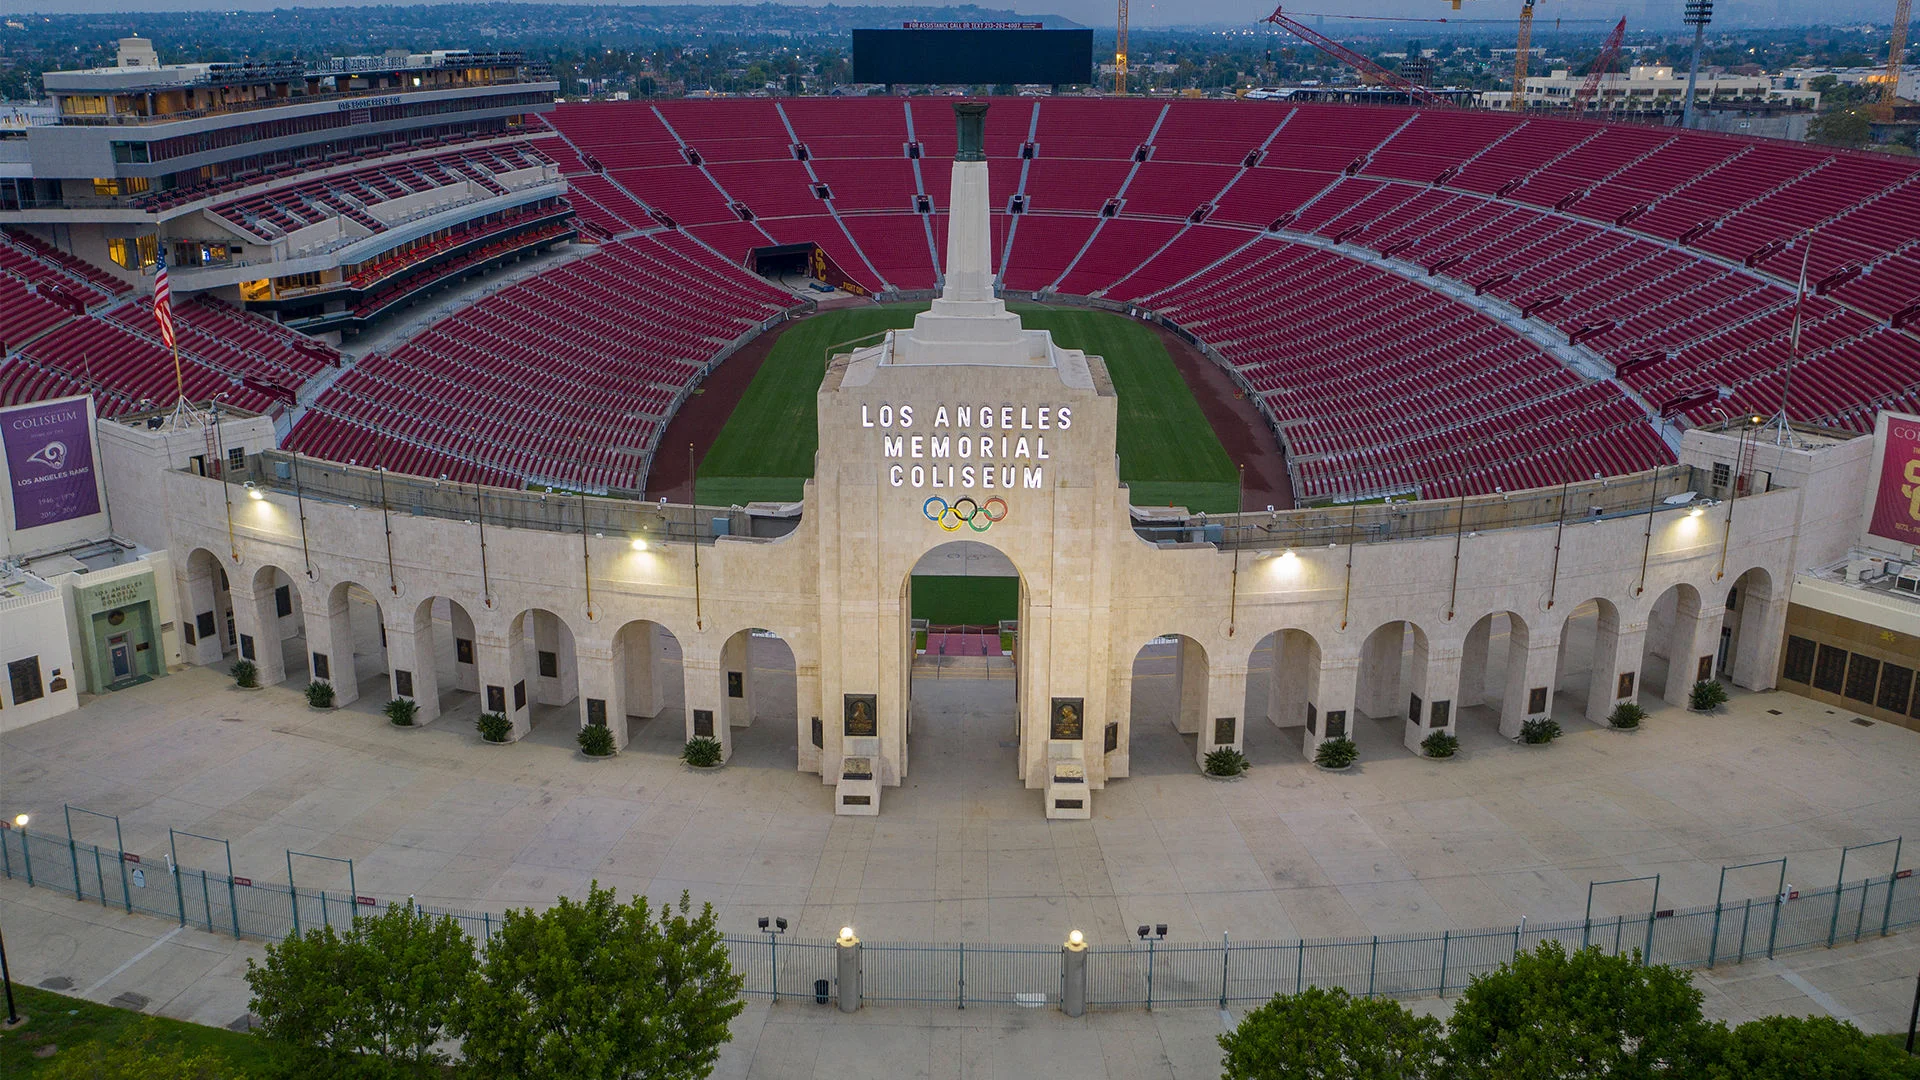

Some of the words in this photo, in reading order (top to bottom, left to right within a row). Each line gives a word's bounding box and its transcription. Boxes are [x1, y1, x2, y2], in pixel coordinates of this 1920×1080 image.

[13, 411, 77, 430] COLISEUM
[862, 404, 913, 429] LOS
[934, 405, 1072, 430] ANGELES
[884, 435, 1049, 459] MEMORIAL
[17, 479, 32, 487] LOS
[33, 472, 68, 484] ANGELES
[69, 466, 89, 476] RAMS
[890, 464, 1042, 489] COLISEUM
[101, 587, 137, 600] MEMORIAL
[103, 594, 136, 606] COLISEUM
